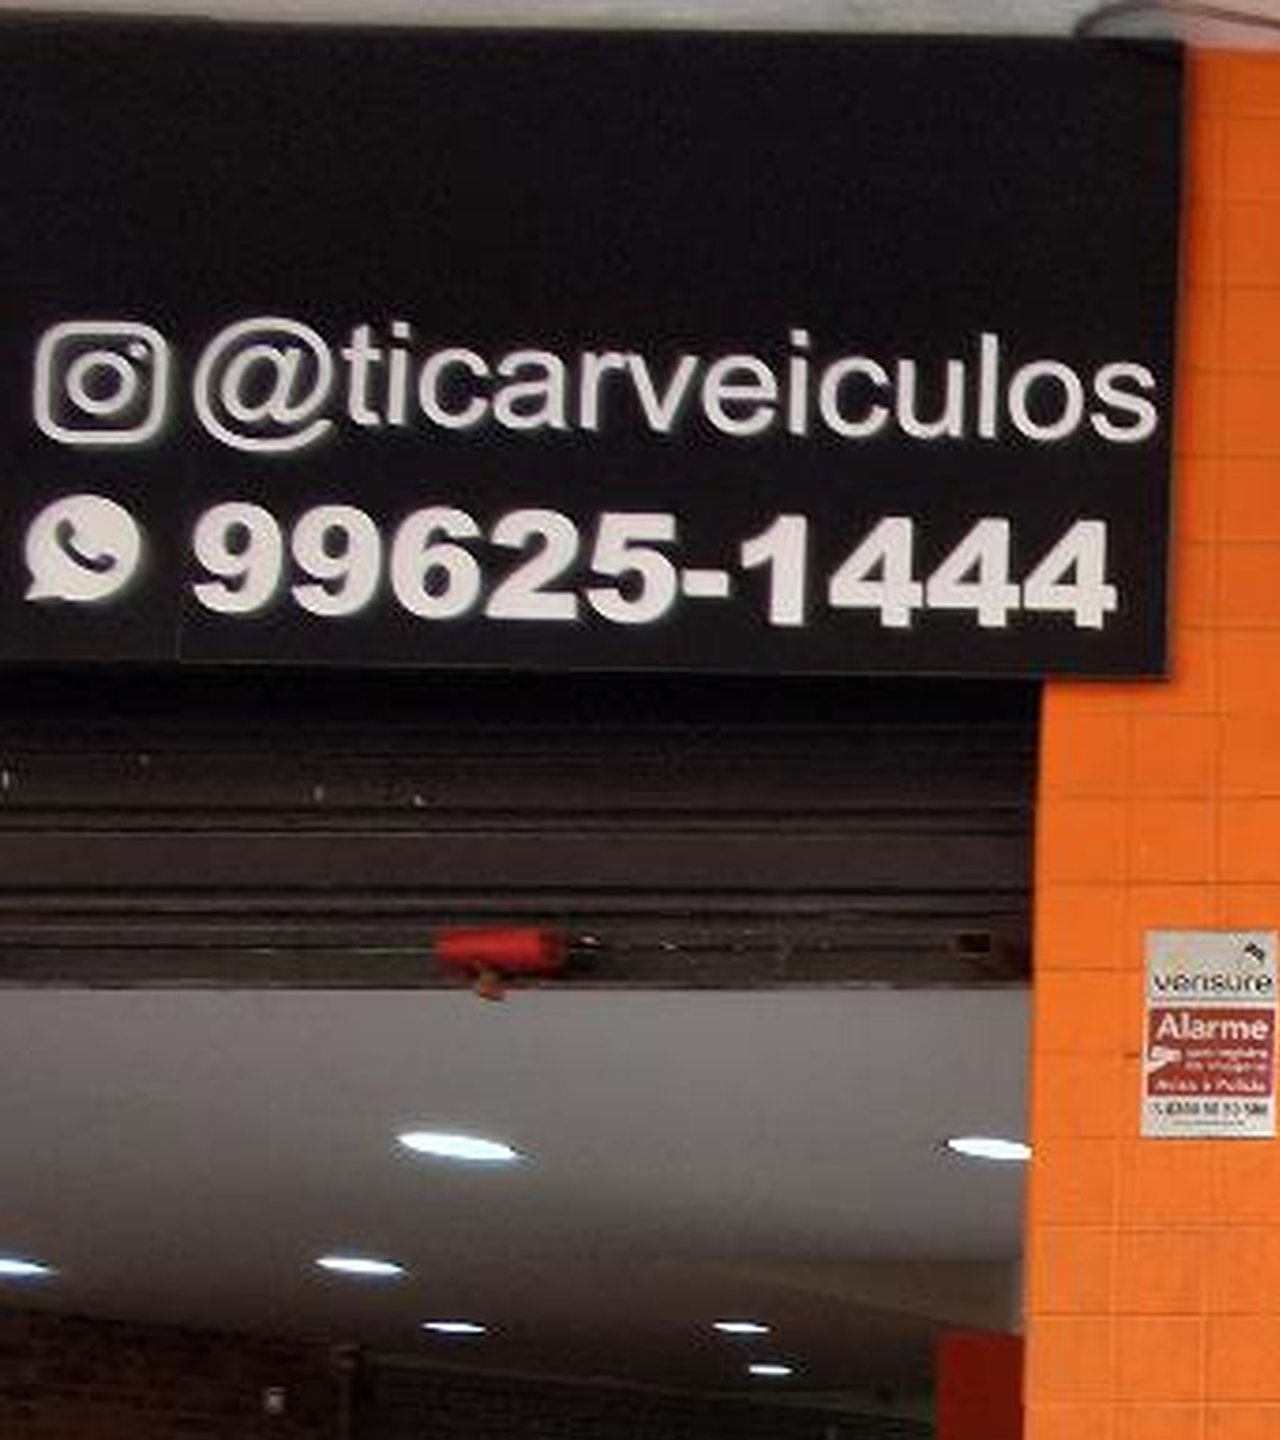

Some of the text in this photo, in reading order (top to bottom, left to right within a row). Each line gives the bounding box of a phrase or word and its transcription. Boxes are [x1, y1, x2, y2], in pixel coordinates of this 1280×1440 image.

[191, 315, 1159, 454] @ticarveiculos
[191, 501, 1119, 630] 99625-1444
[1156, 1012, 1270, 1041] Alarme
